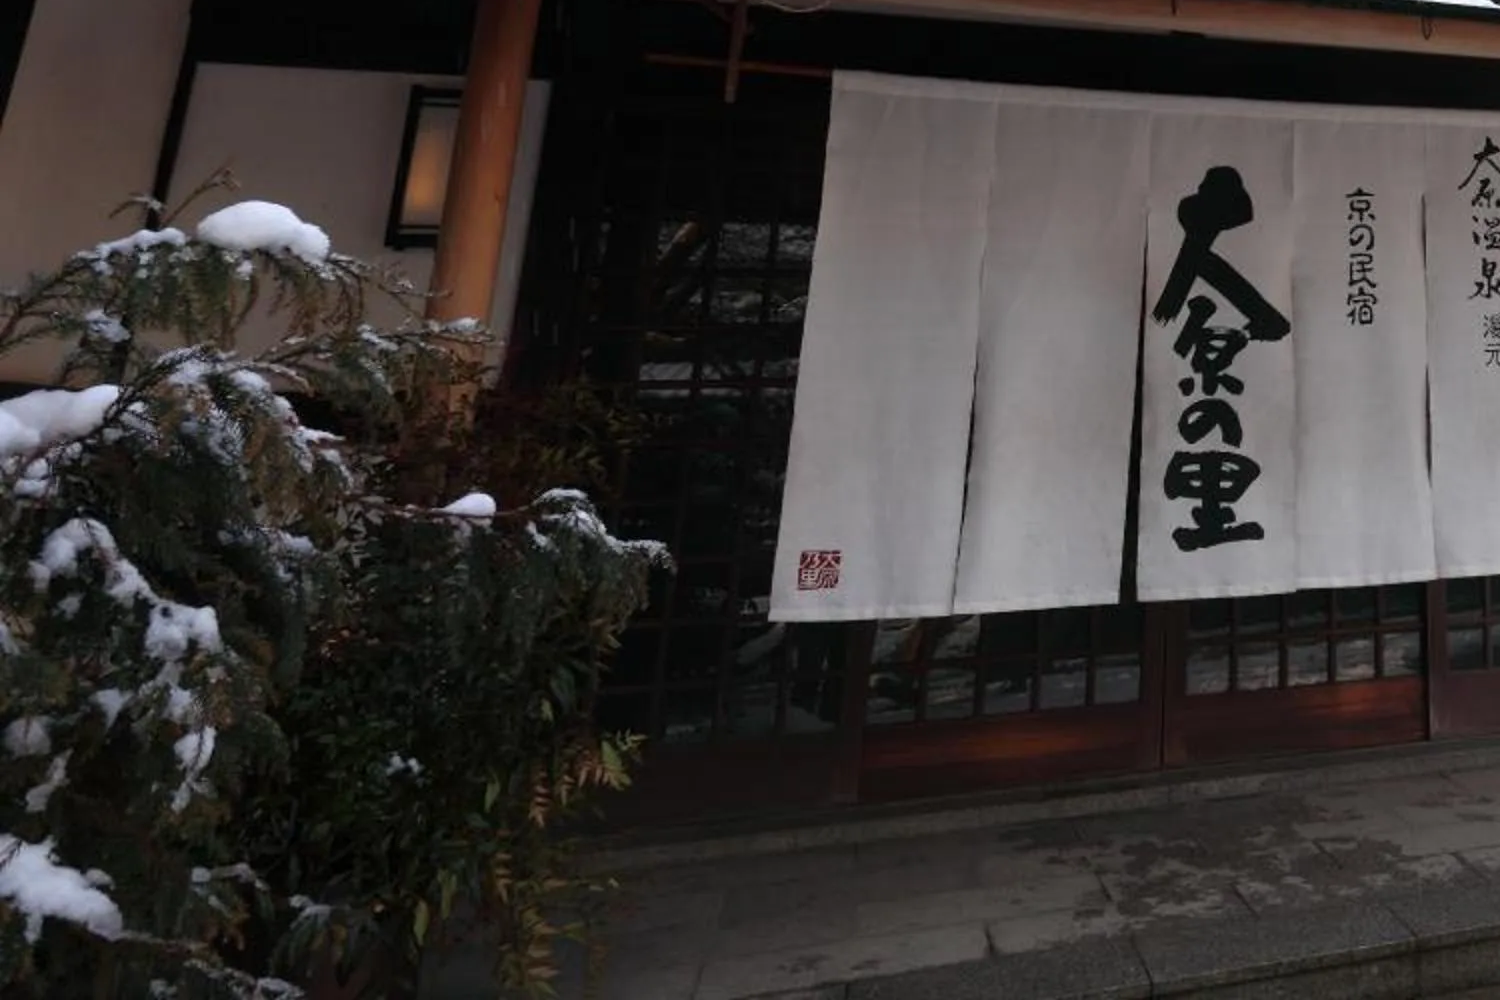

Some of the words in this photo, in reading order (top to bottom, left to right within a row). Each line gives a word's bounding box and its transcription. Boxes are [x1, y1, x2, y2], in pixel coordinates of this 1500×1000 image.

[1152, 165, 1291, 552] 大原の里
[1345, 187, 1379, 327] 京の民宿
